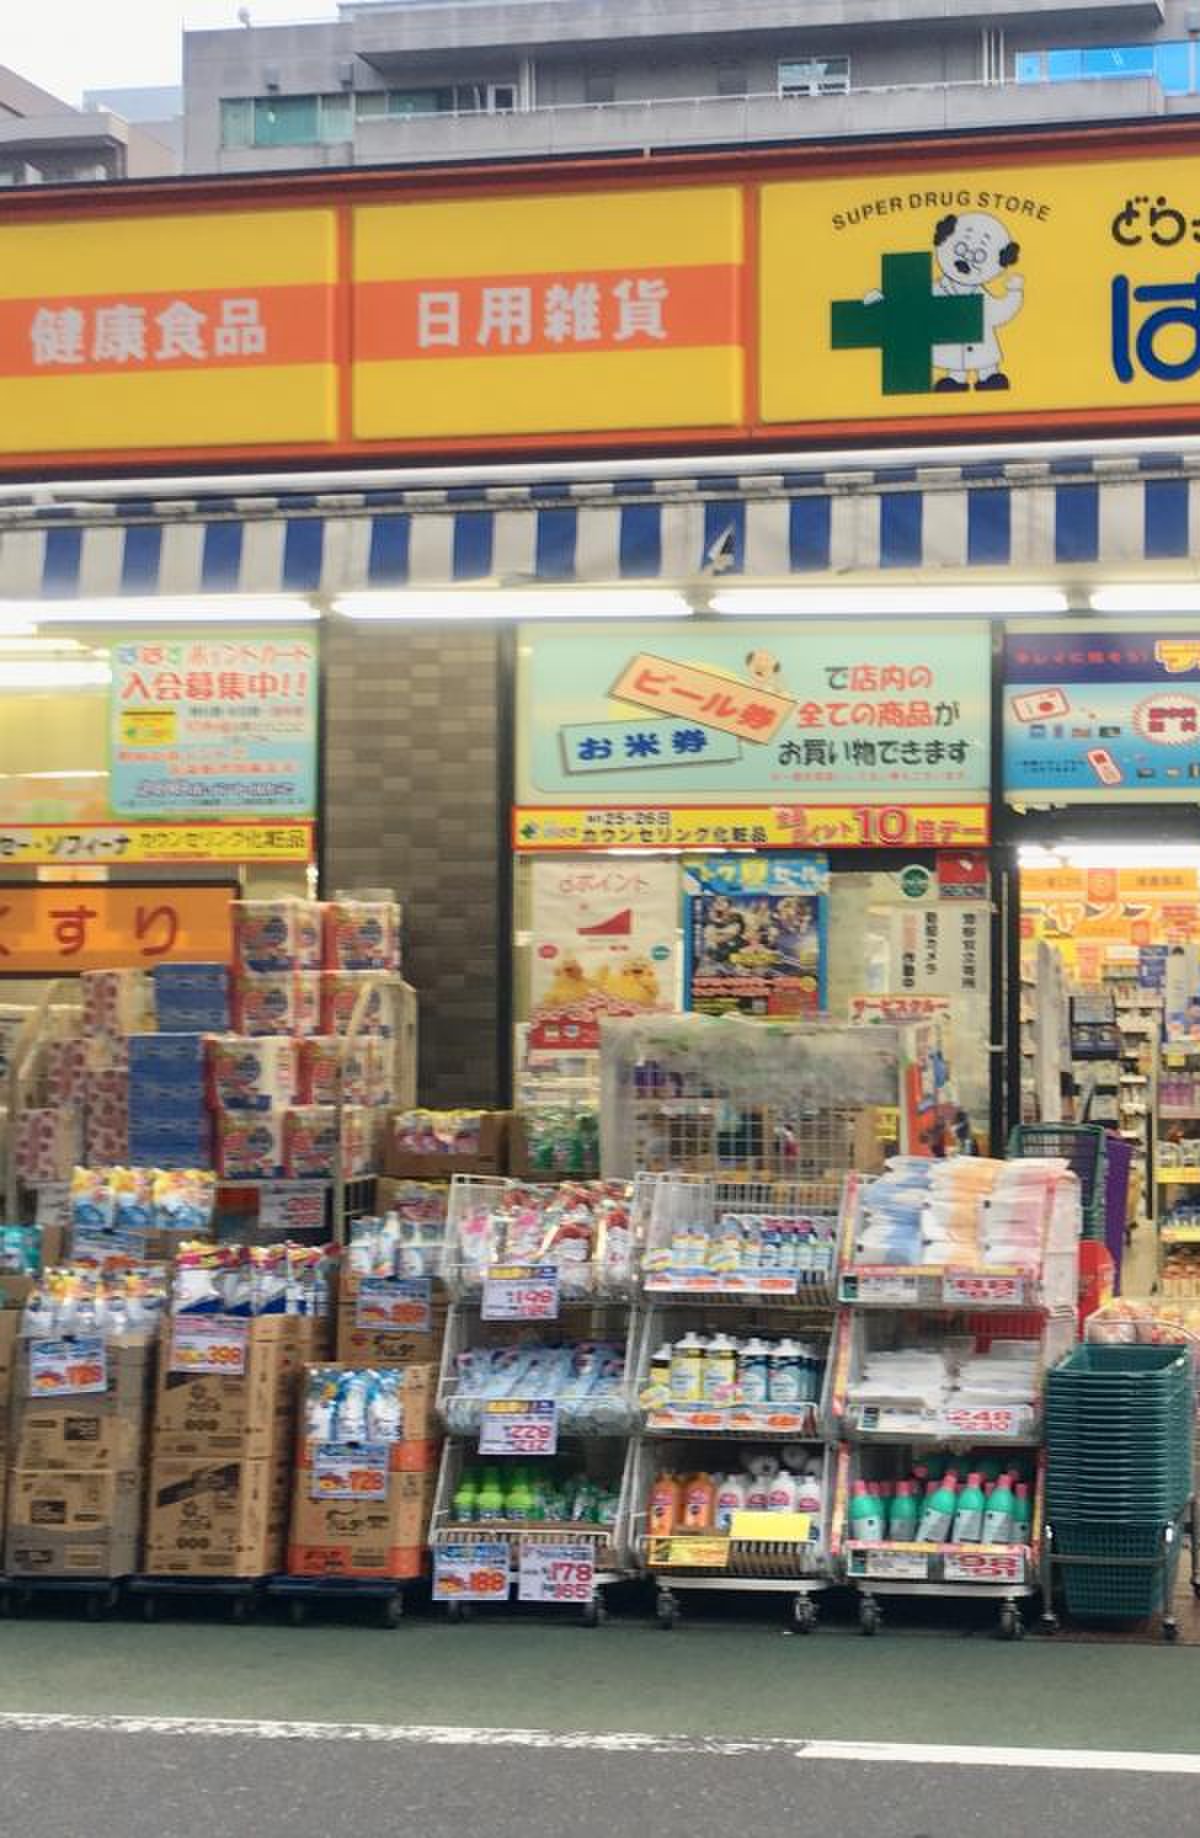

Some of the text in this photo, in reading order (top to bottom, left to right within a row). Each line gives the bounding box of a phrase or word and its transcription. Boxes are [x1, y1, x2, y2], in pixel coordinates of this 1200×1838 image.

[832, 190, 1051, 230] SUPER DRUG STORE
[415, 278, 669, 349] 日用雑貨
[30, 297, 267, 366] 健康食品
[825, 665, 933, 692] で店内の
[632, 668, 778, 731] ビール券
[797, 700, 960, 729] 全ての商品が
[577, 728, 708, 762] お米券
[778, 739, 970, 767] お買い物できます
[549, 1562, 593, 1582] 178
